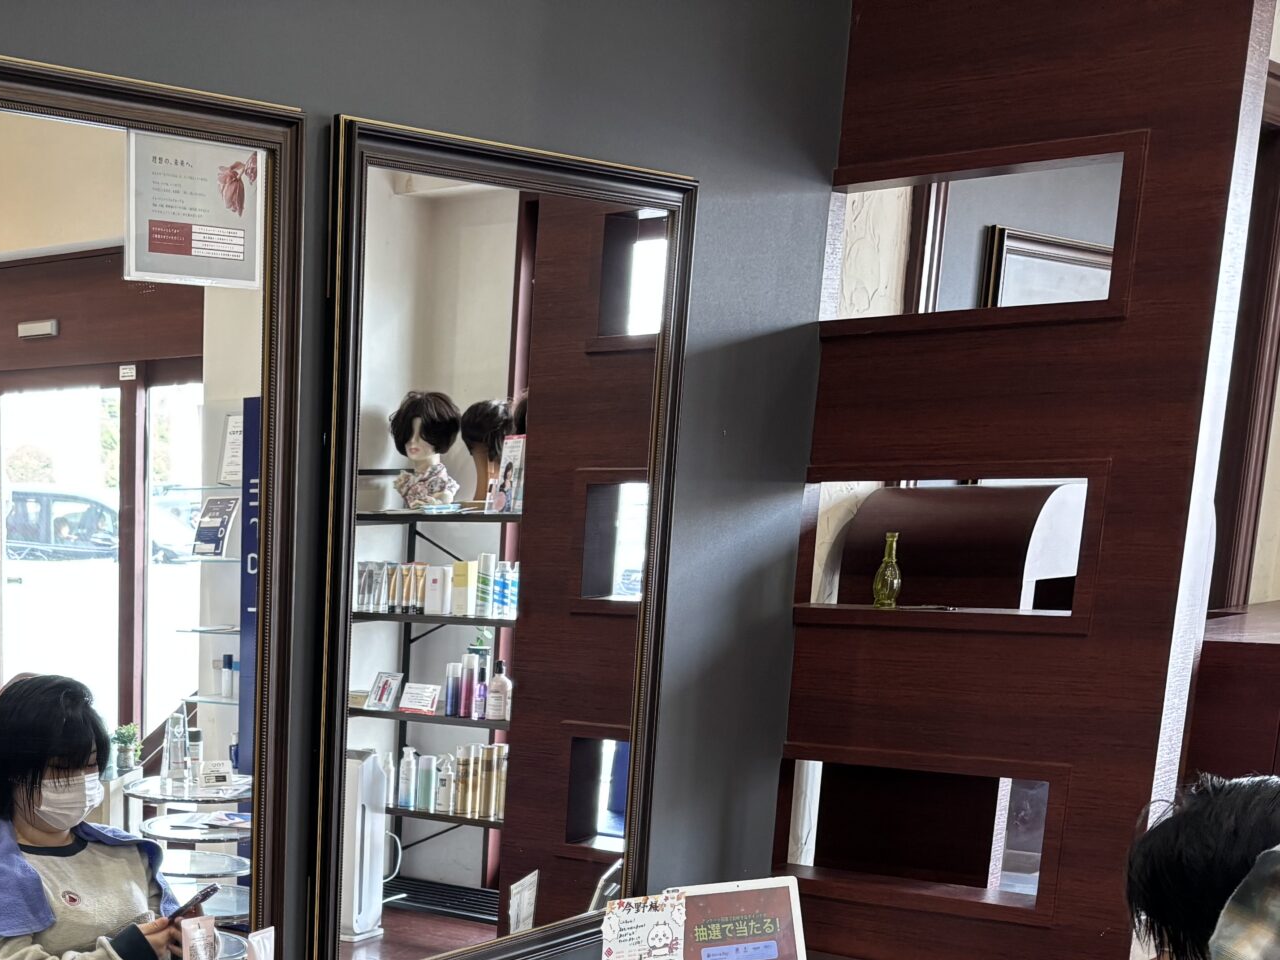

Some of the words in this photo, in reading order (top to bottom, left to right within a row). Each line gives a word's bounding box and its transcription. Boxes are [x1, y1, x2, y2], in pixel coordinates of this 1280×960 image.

[694, 915, 781, 941] 抽選で当たる!
